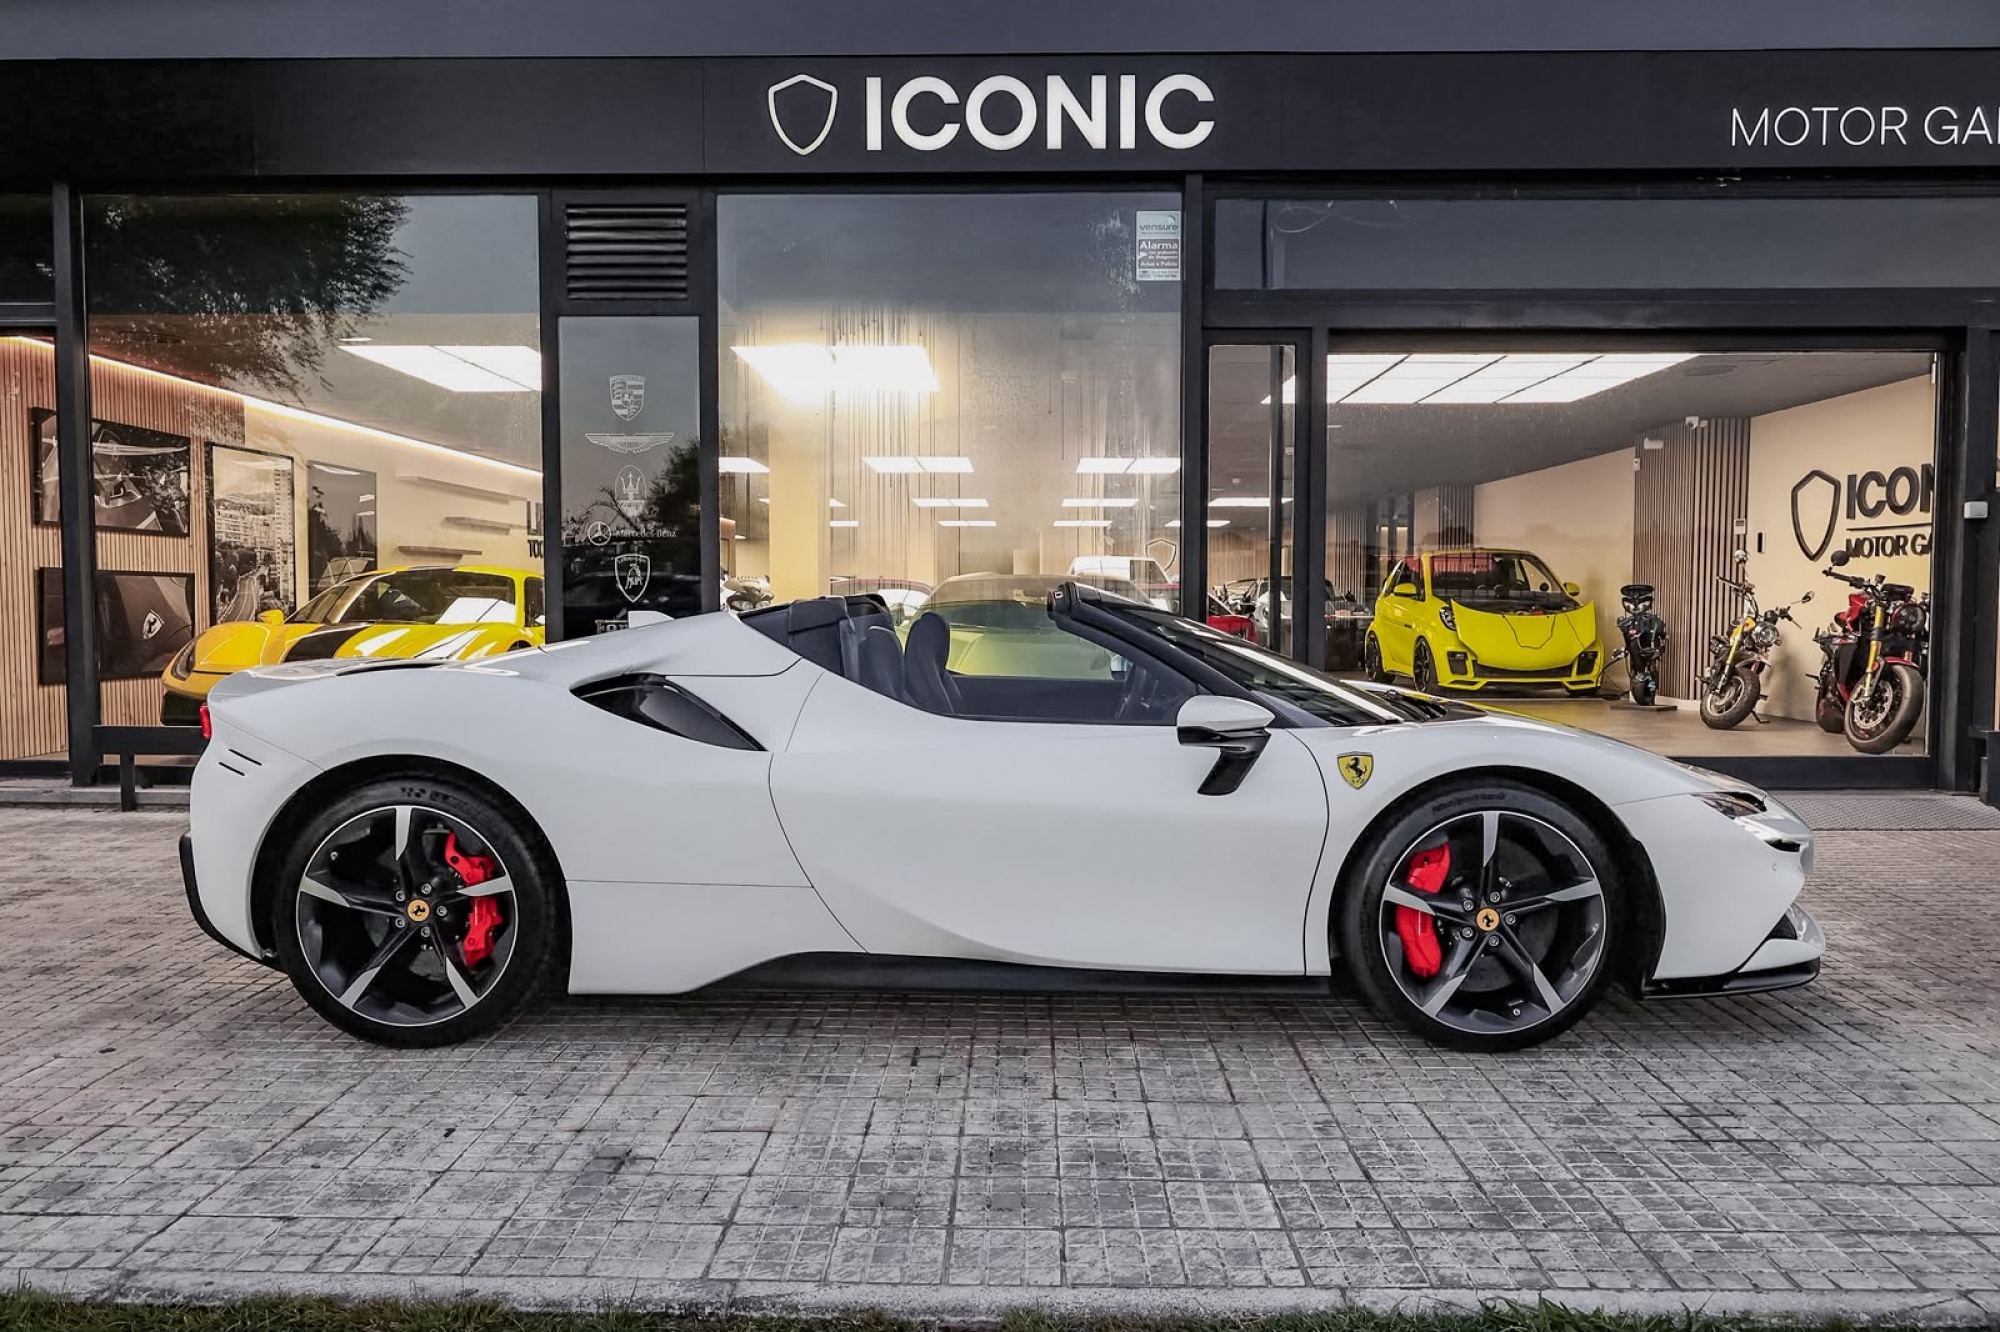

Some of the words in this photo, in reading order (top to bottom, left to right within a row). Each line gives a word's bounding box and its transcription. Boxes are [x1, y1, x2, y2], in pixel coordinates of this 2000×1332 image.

[866, 74, 1216, 152] ICONIC
[1731, 106, 1908, 146] MOTOR
[1923, 106, 2000, 145] GA
[1140, 240, 1178, 250] Alarma
[1845, 535, 1909, 558] MOTOR
